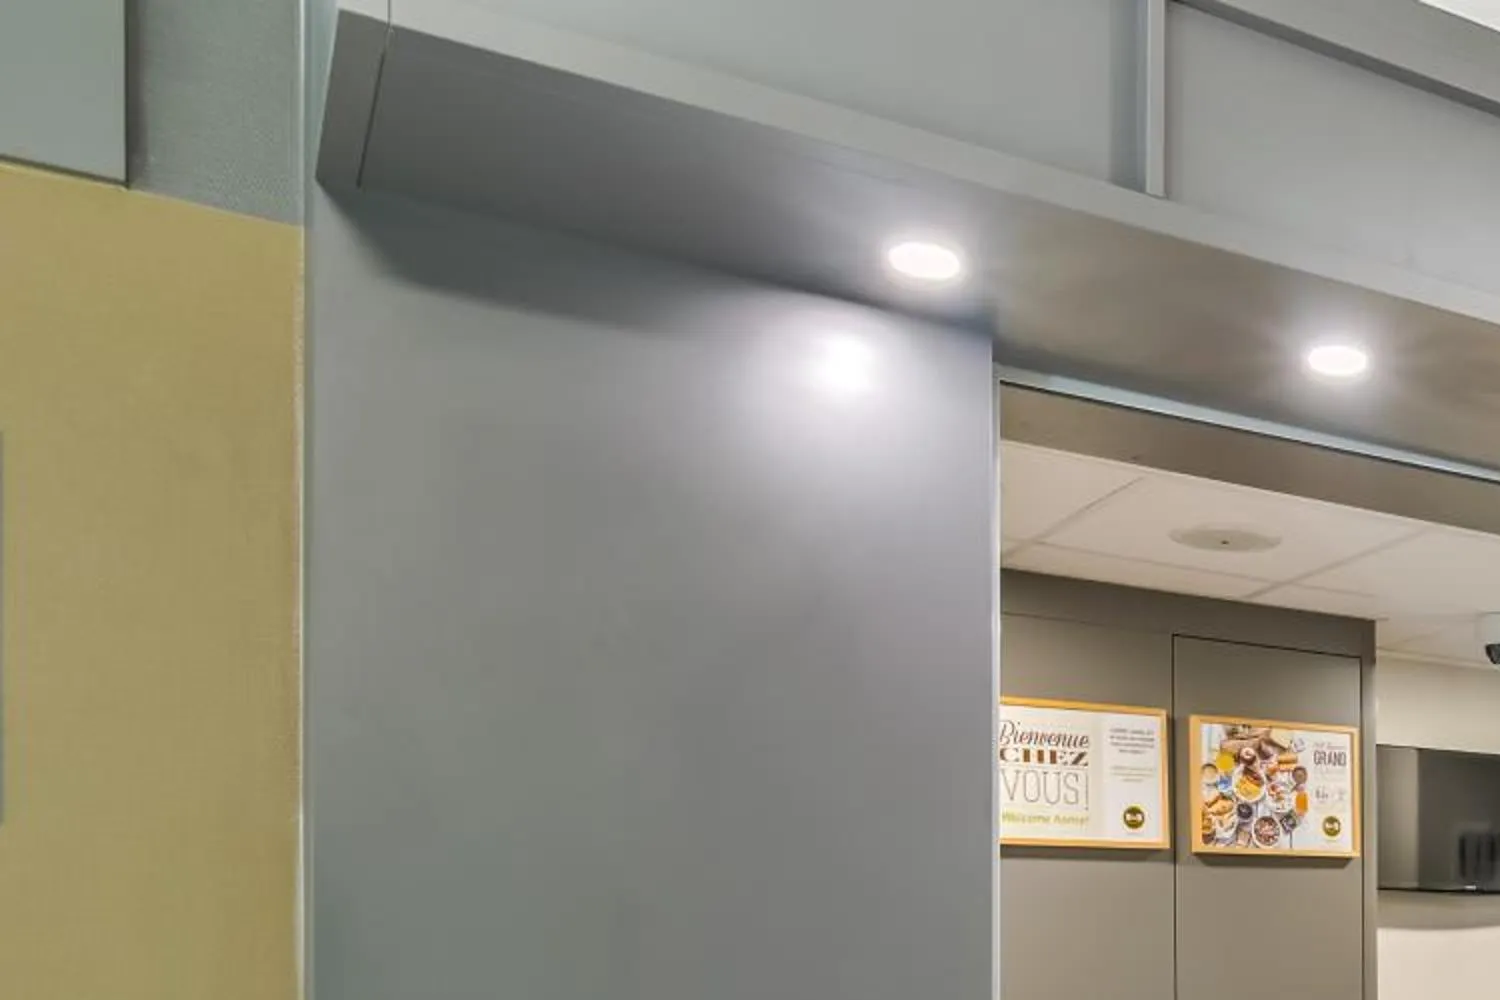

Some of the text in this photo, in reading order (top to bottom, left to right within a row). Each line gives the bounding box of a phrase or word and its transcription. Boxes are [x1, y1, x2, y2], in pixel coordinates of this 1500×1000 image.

[999, 720, 1089, 749] Bienvenue
[999, 747, 1089, 767] CHEZ
[1313, 750, 1347, 767] GRAND
